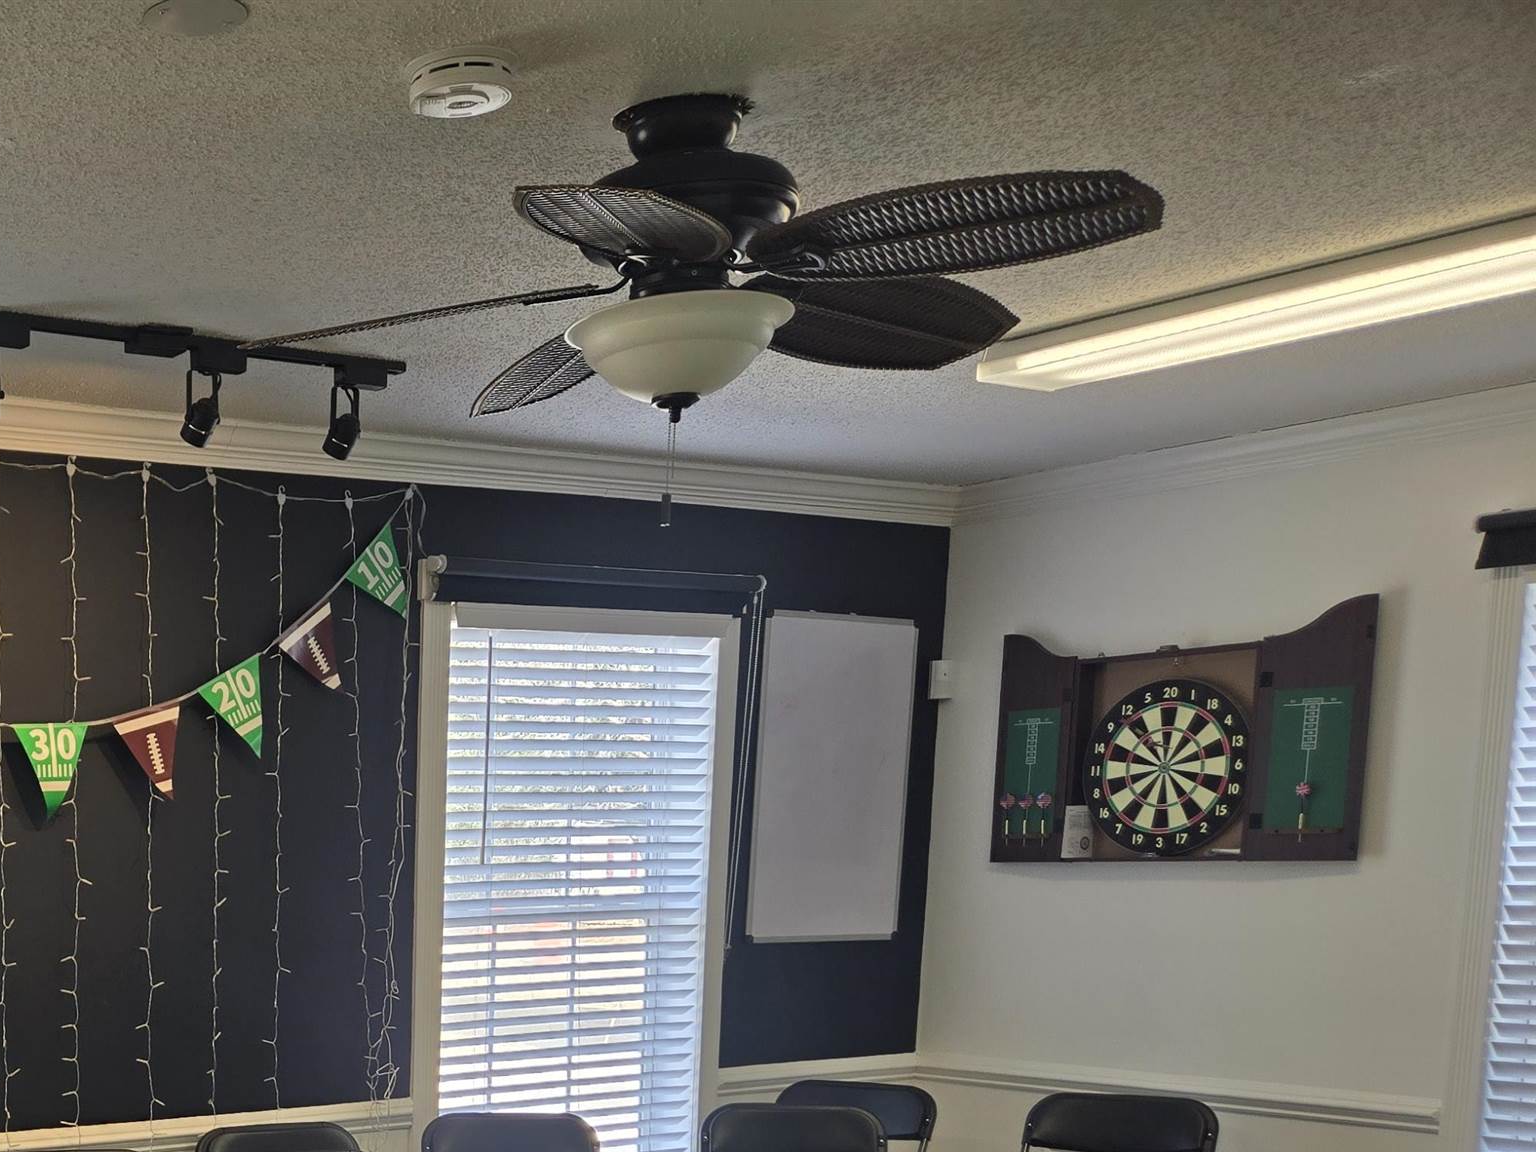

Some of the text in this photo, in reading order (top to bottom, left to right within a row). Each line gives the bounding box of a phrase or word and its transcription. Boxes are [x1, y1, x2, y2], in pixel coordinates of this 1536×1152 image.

[357, 540, 394, 591] 10
[211, 668, 256, 713] 20
[1163, 687, 1178, 698] 20
[1144, 693, 1151, 703] 5
[1207, 699, 1218, 710] 18
[1122, 705, 1133, 715] 12
[1224, 715, 1232, 725] 4
[1108, 722, 1114, 732] 9
[29, 728, 77, 761] 30
[1232, 735, 1243, 746] 13
[1095, 743, 1105, 753] 14
[1235, 759, 1242, 770] 6
[1091, 766, 1100, 776] 11
[1093, 788, 1100, 798] 8
[1228, 784, 1239, 794] 10
[1100, 808, 1109, 818] 16
[1216, 805, 1227, 815] 15
[1116, 824, 1122, 834] 7
[1200, 822, 1207, 832] 2
[1132, 834, 1143, 844] 19
[1156, 837, 1162, 848] 3
[1176, 833, 1187, 844] 17
